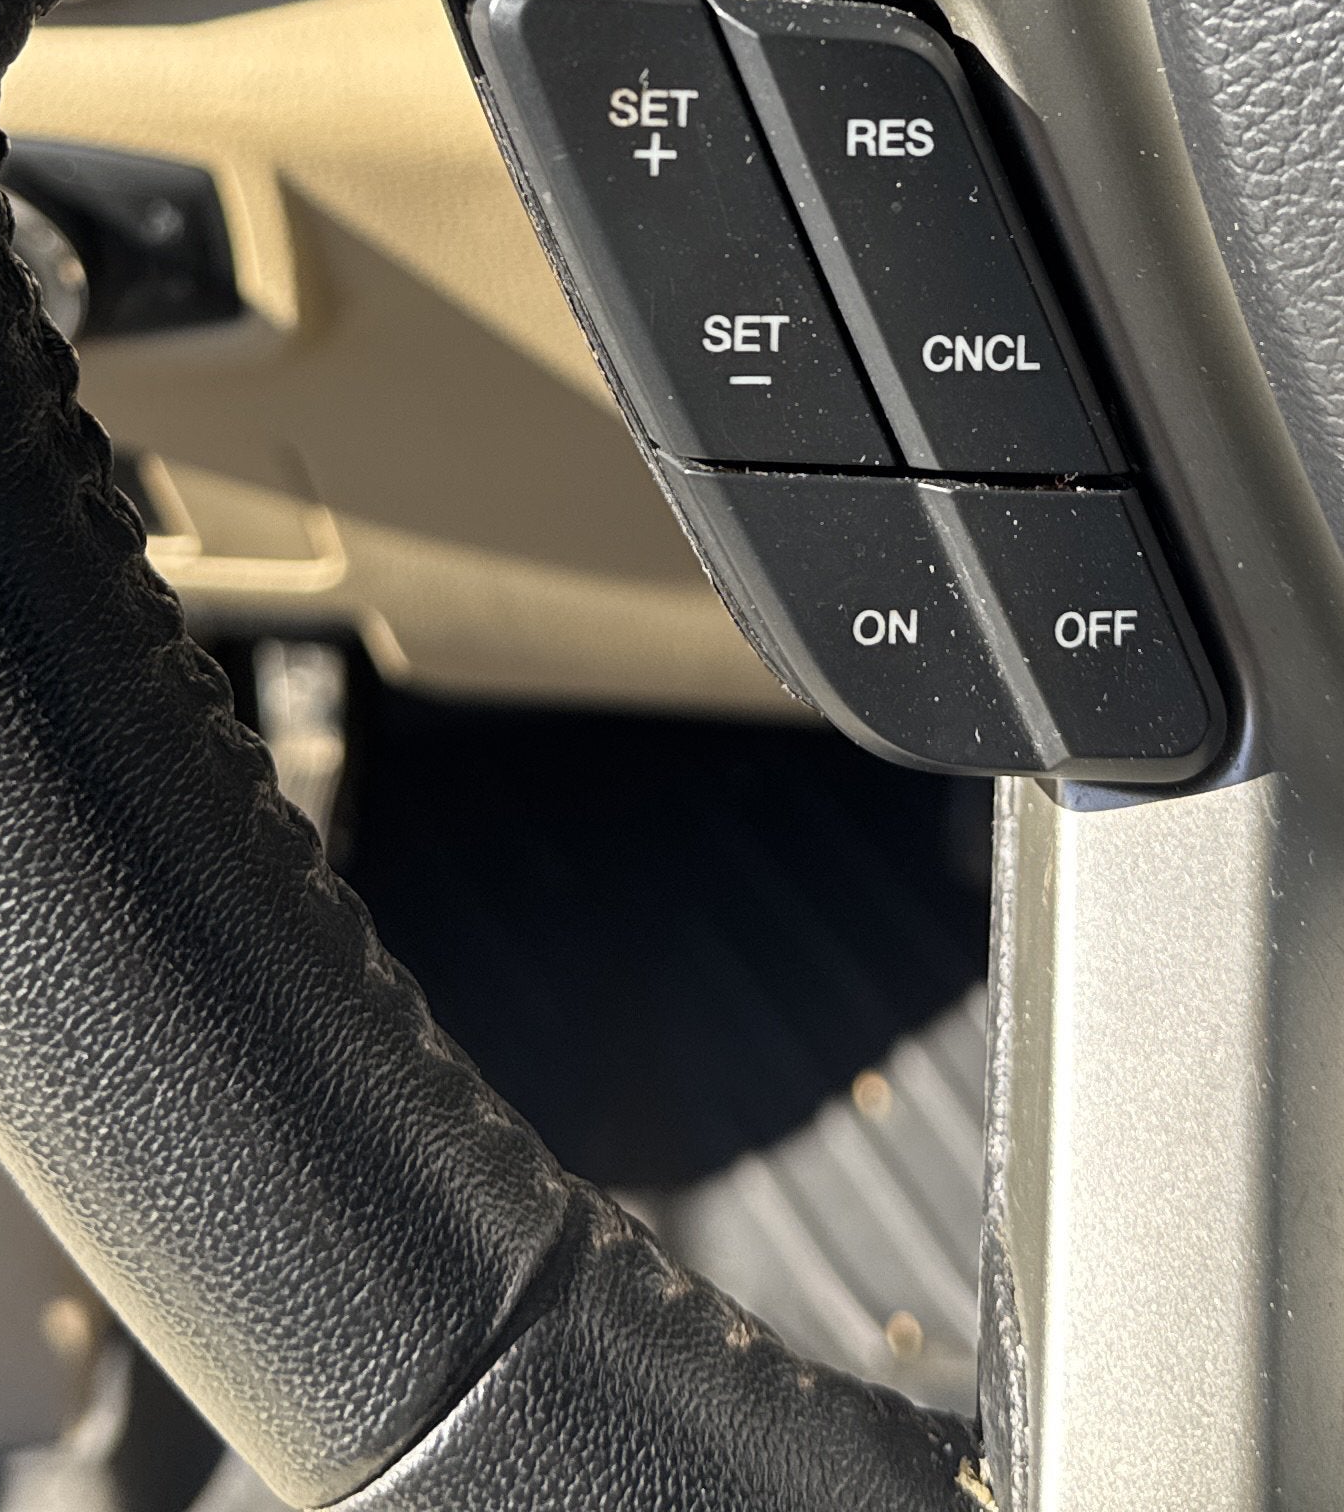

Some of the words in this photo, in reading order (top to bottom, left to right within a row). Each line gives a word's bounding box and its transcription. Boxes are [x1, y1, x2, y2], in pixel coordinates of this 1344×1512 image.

[608, 88, 698, 128] SET
[846, 119, 935, 158] RES
[702, 315, 790, 353] SET
[921, 334, 1041, 373] CNCL
[852, 610, 918, 646] ON
[1054, 609, 1138, 648] OFF
